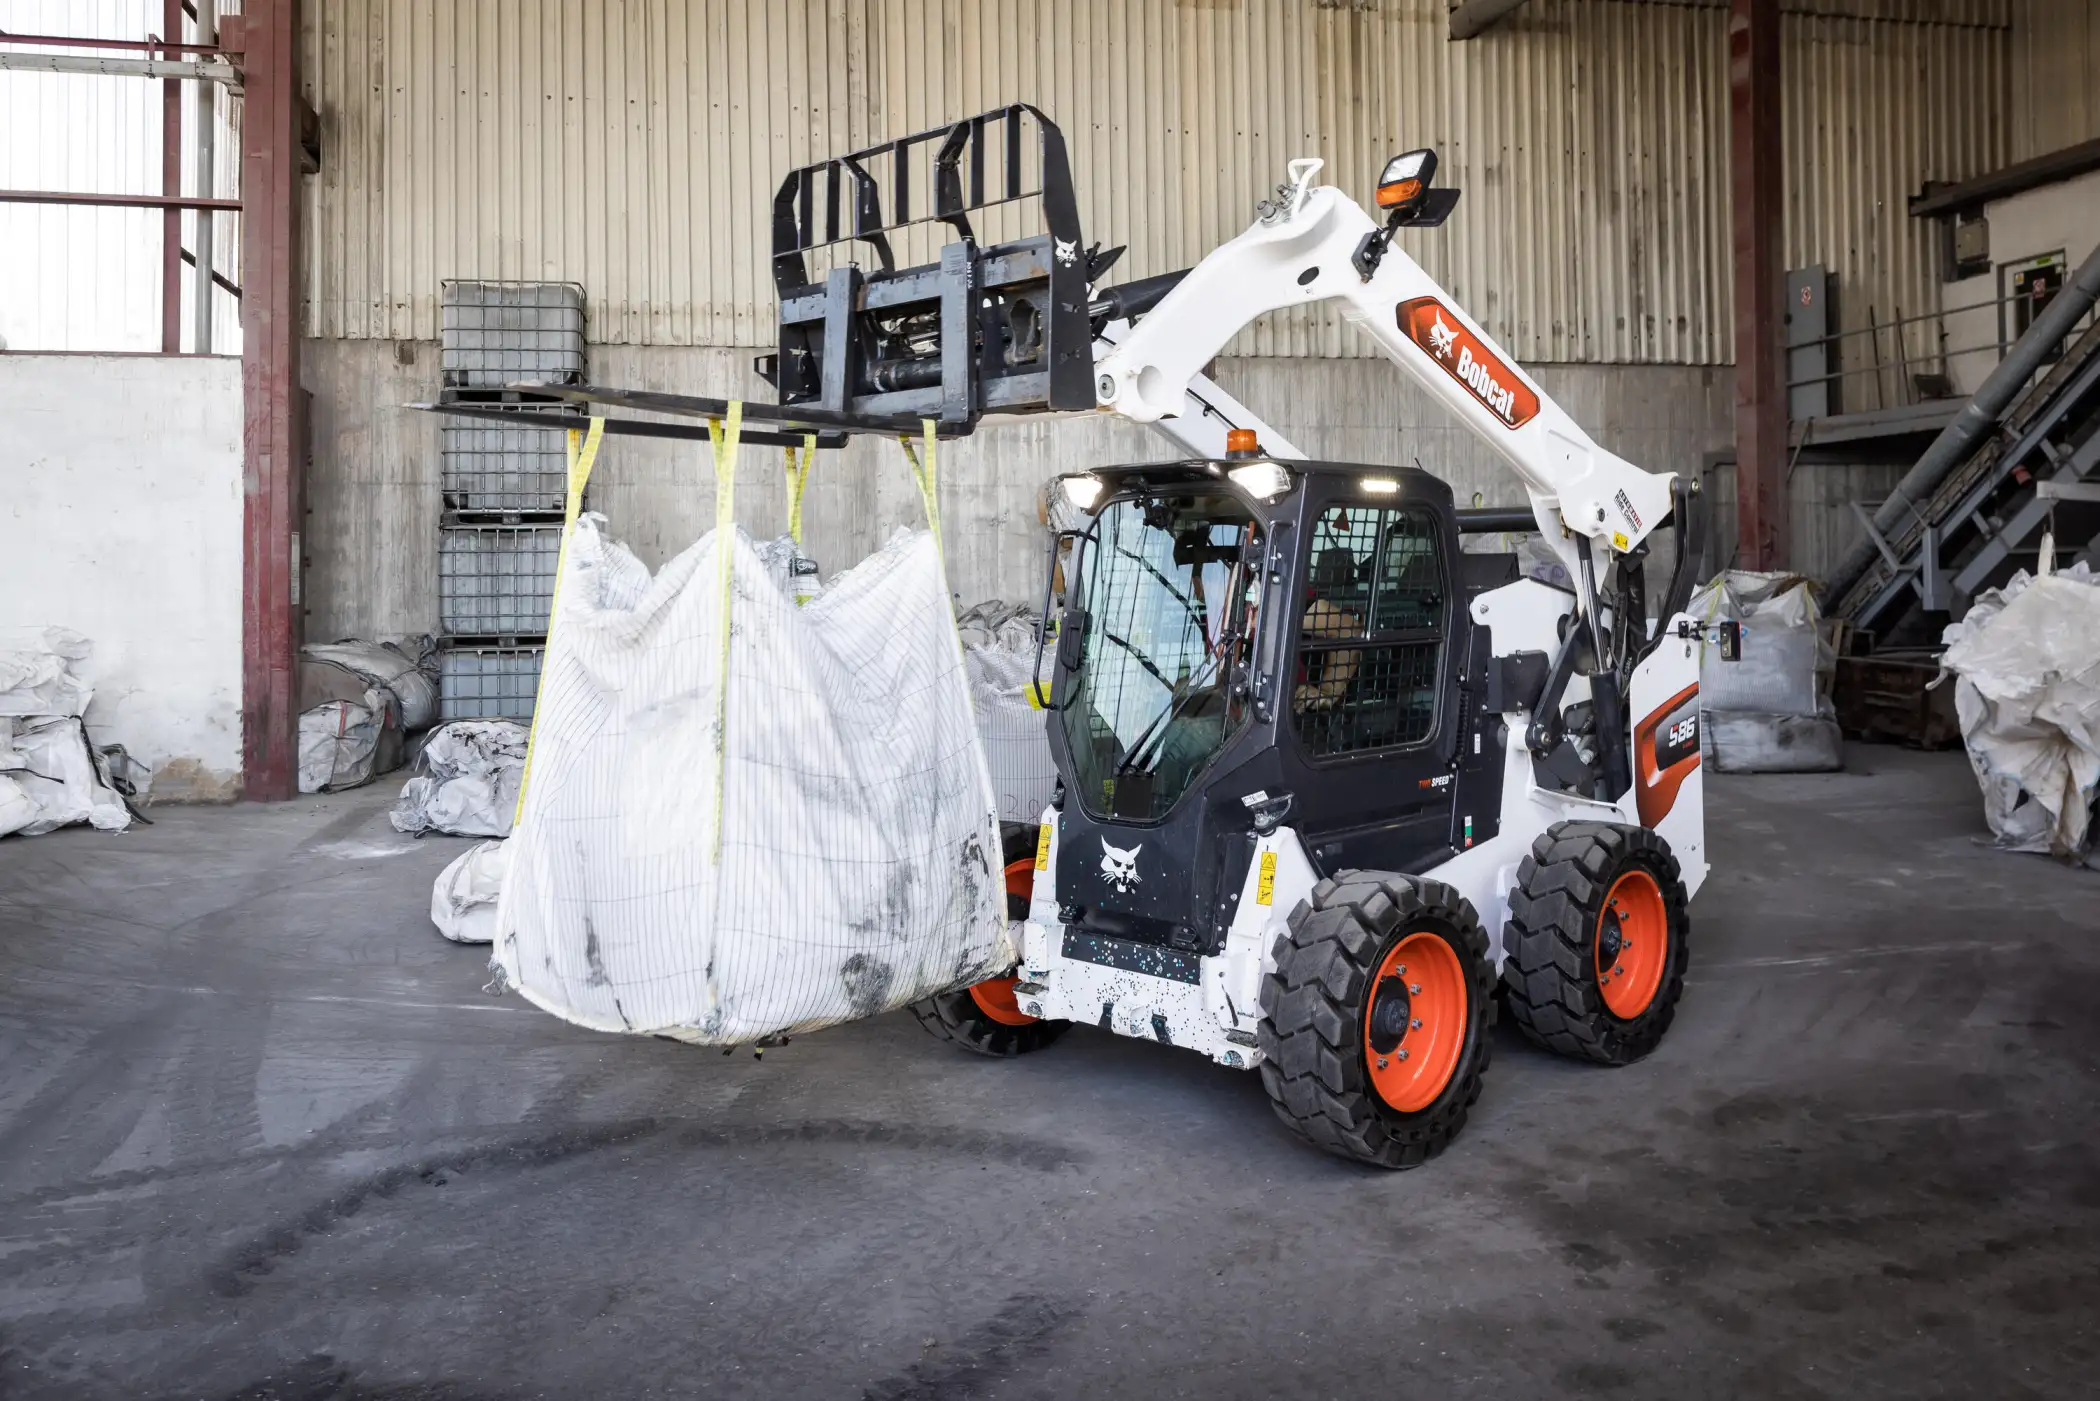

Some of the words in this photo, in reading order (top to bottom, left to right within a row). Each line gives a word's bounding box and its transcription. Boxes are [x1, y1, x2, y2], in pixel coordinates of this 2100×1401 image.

[1456, 344, 1515, 421] Bobcat
[1614, 493, 1625, 510] Ride
[1624, 509, 1639, 534] Control
[1668, 716, 1695, 747] S86
[1431, 775, 1450, 788] SPEED
